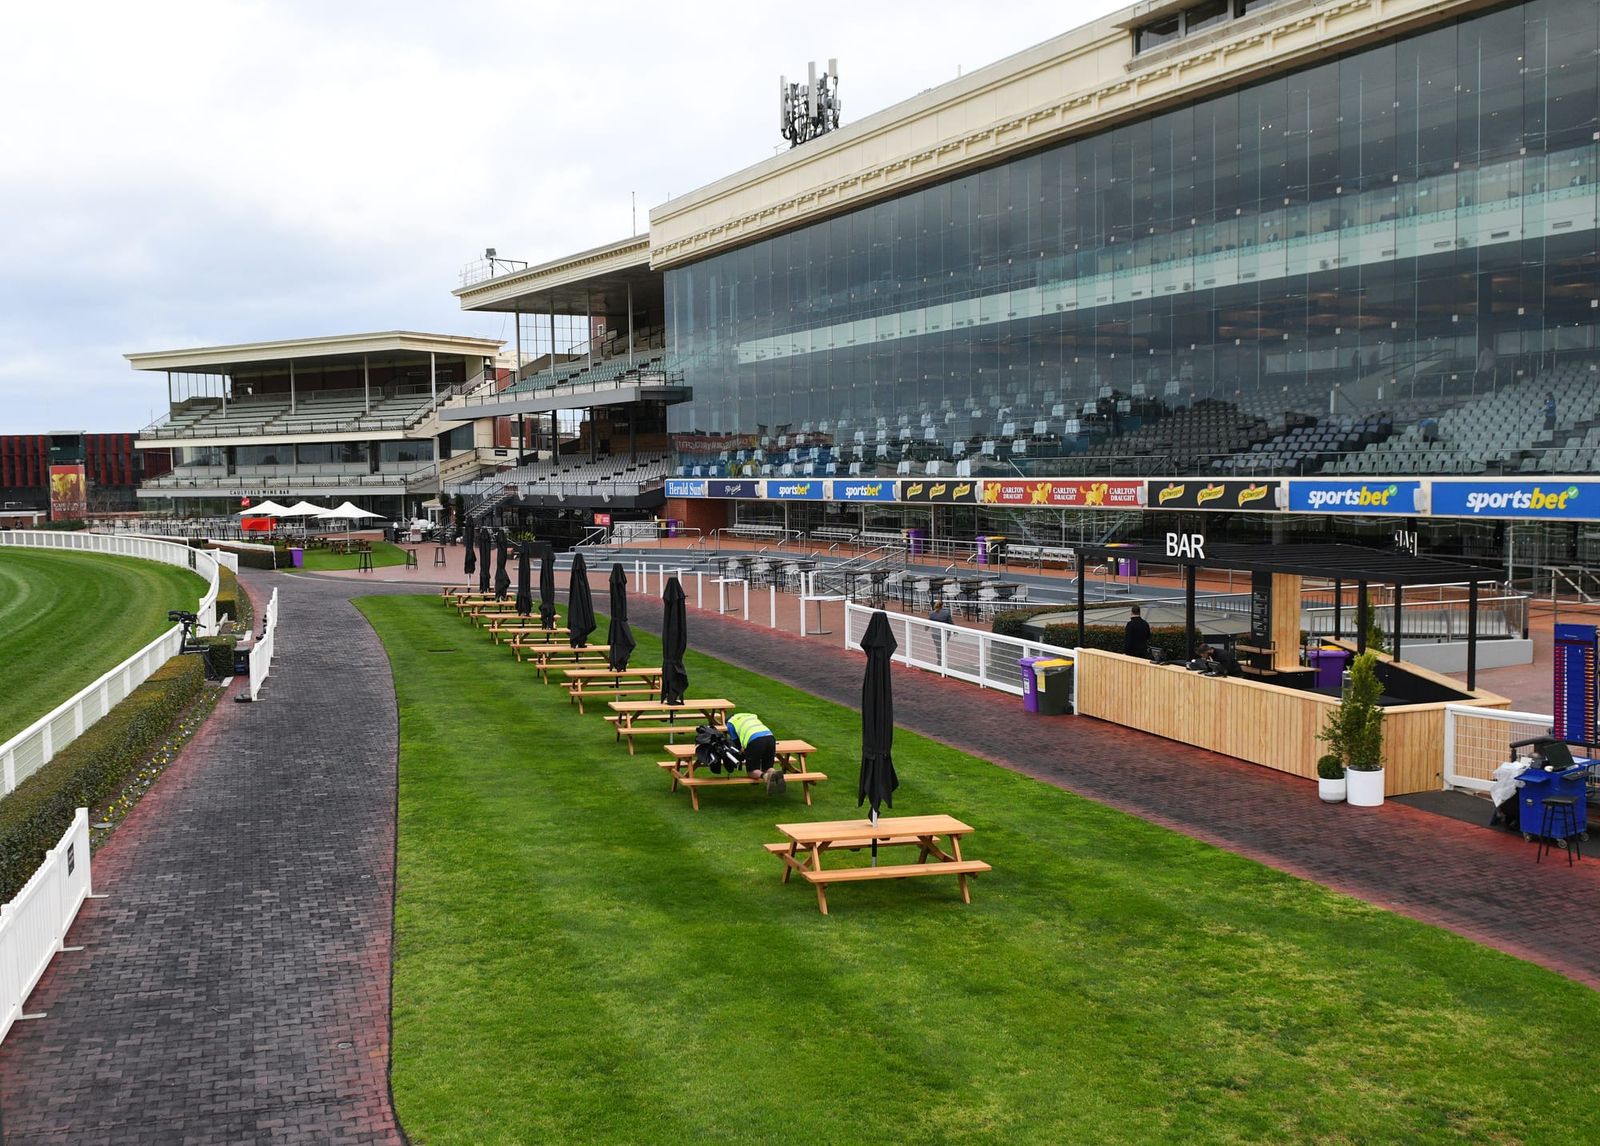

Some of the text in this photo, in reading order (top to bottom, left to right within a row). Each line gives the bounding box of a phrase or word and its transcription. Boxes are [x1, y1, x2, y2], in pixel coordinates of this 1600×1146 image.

[669, 483, 702, 495] Herald Sun
[779, 484, 807, 497] sportsbet
[845, 484, 879, 499] sportsbet
[1109, 487, 1136, 495] CARLTON
[1110, 494, 1135, 502] DRAUGHT
[1308, 486, 1389, 508] sportsbet
[1466, 487, 1567, 512] sportsbet
[1166, 532, 1205, 559] BAR
